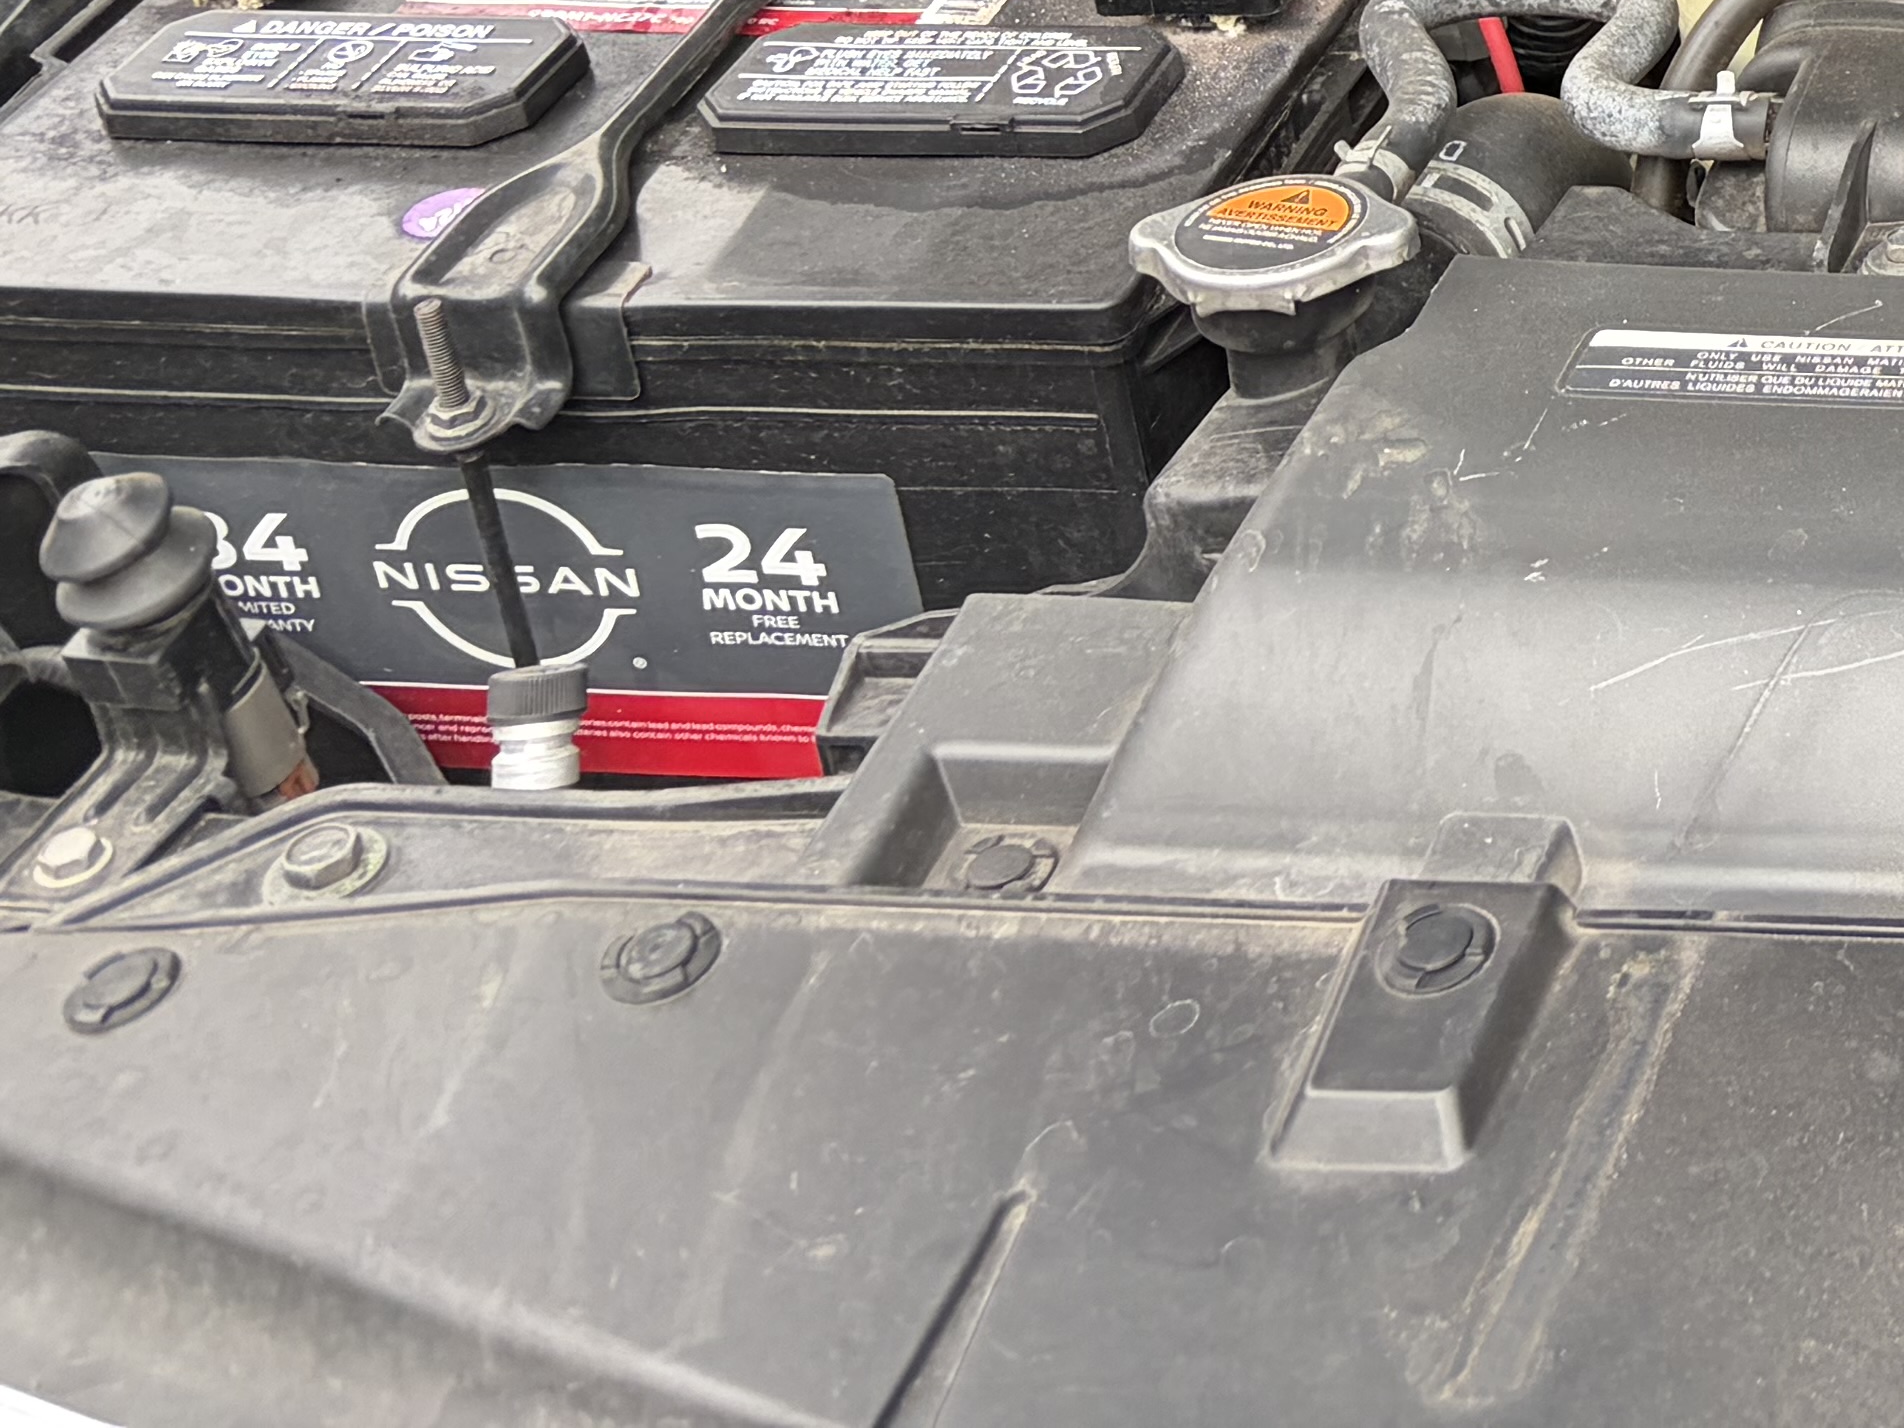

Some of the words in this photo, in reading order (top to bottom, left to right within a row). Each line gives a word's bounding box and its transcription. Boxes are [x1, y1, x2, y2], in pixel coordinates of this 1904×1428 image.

[260, 20, 372, 35] DANGER
[392, 22, 496, 39] POISON
[1216, 207, 1338, 228] AVERTISSEMENT
[1248, 200, 1329, 217] WARNING
[1760, 340, 1851, 353] CAUTION
[1621, 356, 1676, 367] OTHER
[1690, 359, 1746, 370] FLUIDS
[1762, 362, 1798, 372] WILL
[1814, 364, 1882, 375] DAMAGE
[1696, 350, 1739, 360] ONLY
[1751, 353, 1783, 362] USE
[1795, 355, 1855, 366] NISSAN
[1608, 378, 1681, 390] D'AUTRES
[1687, 381, 1756, 393] LIQUIDES
[1761, 375, 1792, 384] QUE
[1795, 376, 1816, 386] DU
[1818, 376, 1873, 388] LIQUIDE
[695, 522, 827, 586] 24
[218, 574, 321, 599] ONTH
[372, 560, 641, 599] NISSAN
[238, 601, 297, 616] MITED
[702, 587, 840, 614] MONTH
[752, 614, 801, 629] FREE
[709, 630, 850, 648] REPLACEMENT
